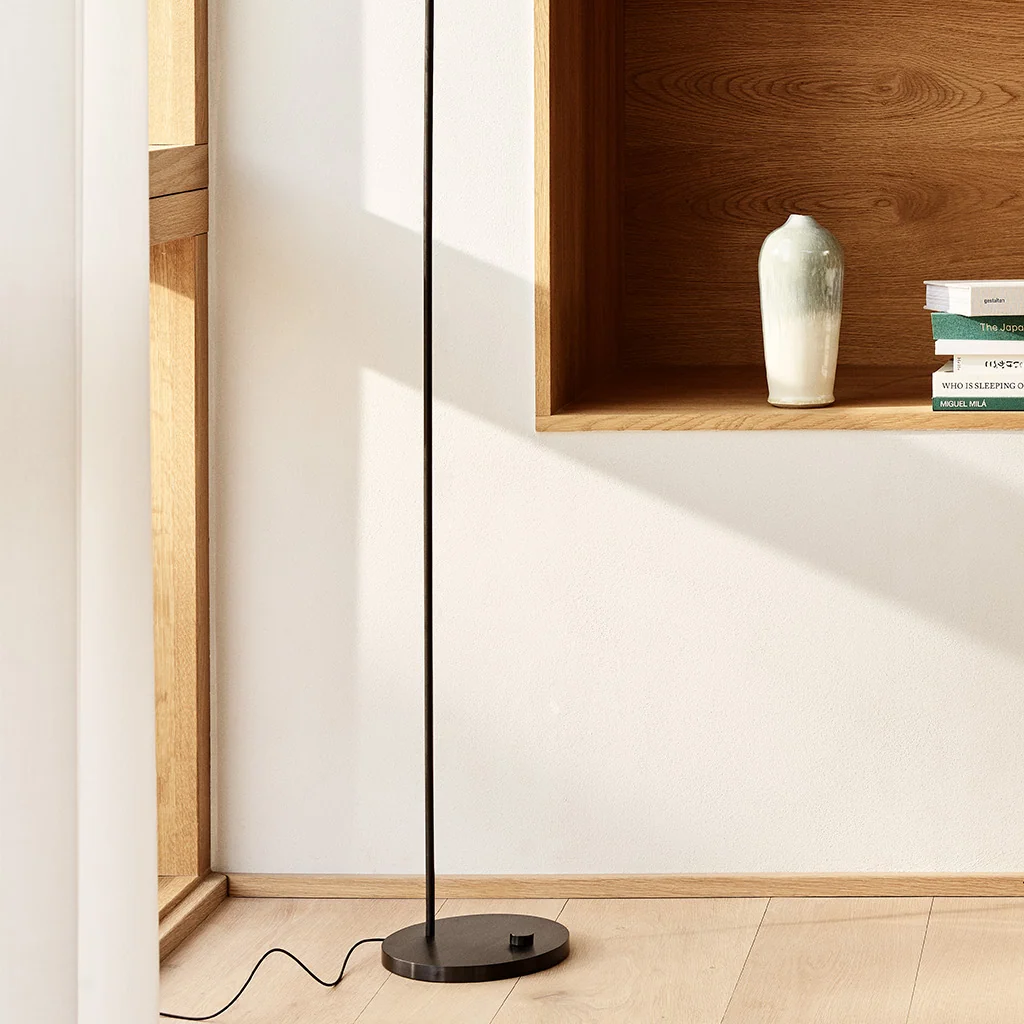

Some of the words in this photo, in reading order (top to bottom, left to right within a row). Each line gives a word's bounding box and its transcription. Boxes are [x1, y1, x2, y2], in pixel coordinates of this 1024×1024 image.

[980, 322, 998, 332] The
[942, 381, 963, 390] WHO
[965, 381, 973, 390] IS
[974, 381, 1016, 390] SLEEPING
[969, 398, 986, 407] MILÁ
